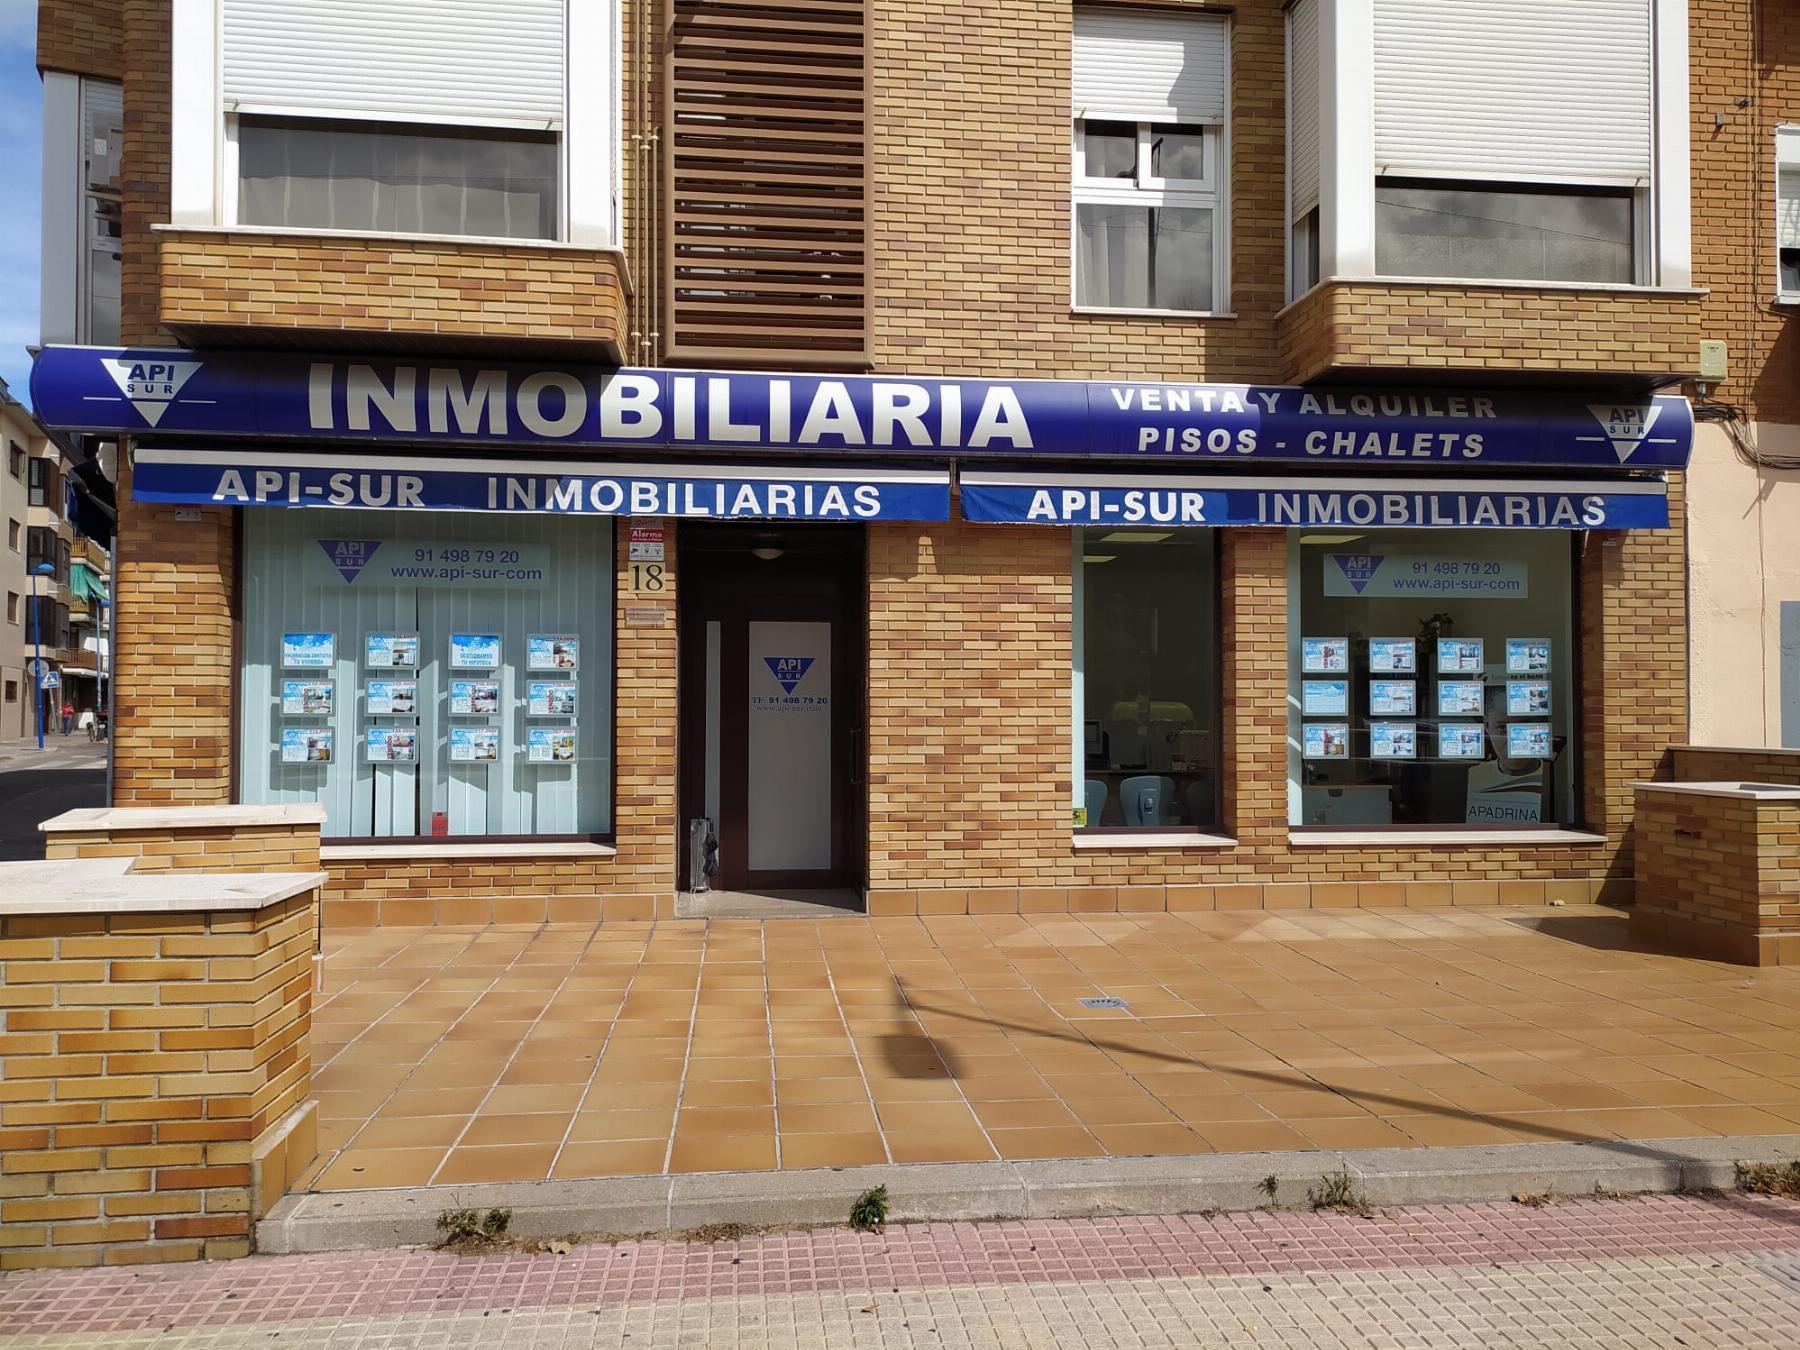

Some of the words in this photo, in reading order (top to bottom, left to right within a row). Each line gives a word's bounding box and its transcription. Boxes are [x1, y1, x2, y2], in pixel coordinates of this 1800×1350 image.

[128, 363, 176, 382] API
[126, 383, 174, 395] SUR
[308, 362, 1034, 449] INMOBILIARIA
[1111, 386, 1246, 413] VENTA
[1256, 390, 1283, 414] Y
[1298, 392, 1498, 421] ALQUILER
[1609, 405, 1647, 424] API
[1609, 424, 1647, 436] SUR
[1138, 426, 1258, 453] PISOS
[1304, 430, 1485, 458] CHALETS
[211, 469, 426, 508] API-SUR
[487, 475, 882, 518] INMOBILIARIAS
[1026, 490, 1207, 523] API-SUR
[1257, 492, 1607, 527] INMOBILIARIAS
[632, 530, 662, 538] Alarma
[335, 542, 365, 555] API
[415, 549, 433, 562] 91
[440, 549, 470, 563] 498
[476, 550, 495, 563] 79
[500, 550, 520, 563] 20
[1347, 556, 1372, 569] API
[391, 566, 542, 581] www.api-sur-com
[1347, 570, 1372, 578] SUR
[1412, 562, 1428, 574] 91
[1433, 562, 1459, 575] 498
[1463, 563, 1480, 575] 79
[1483, 563, 1501, 575] 20
[631, 564, 664, 591] 18
[1393, 578, 1520, 592] www.api-sur-com
[778, 659, 801, 670] API
[1468, 805, 1538, 823] APADRINA
